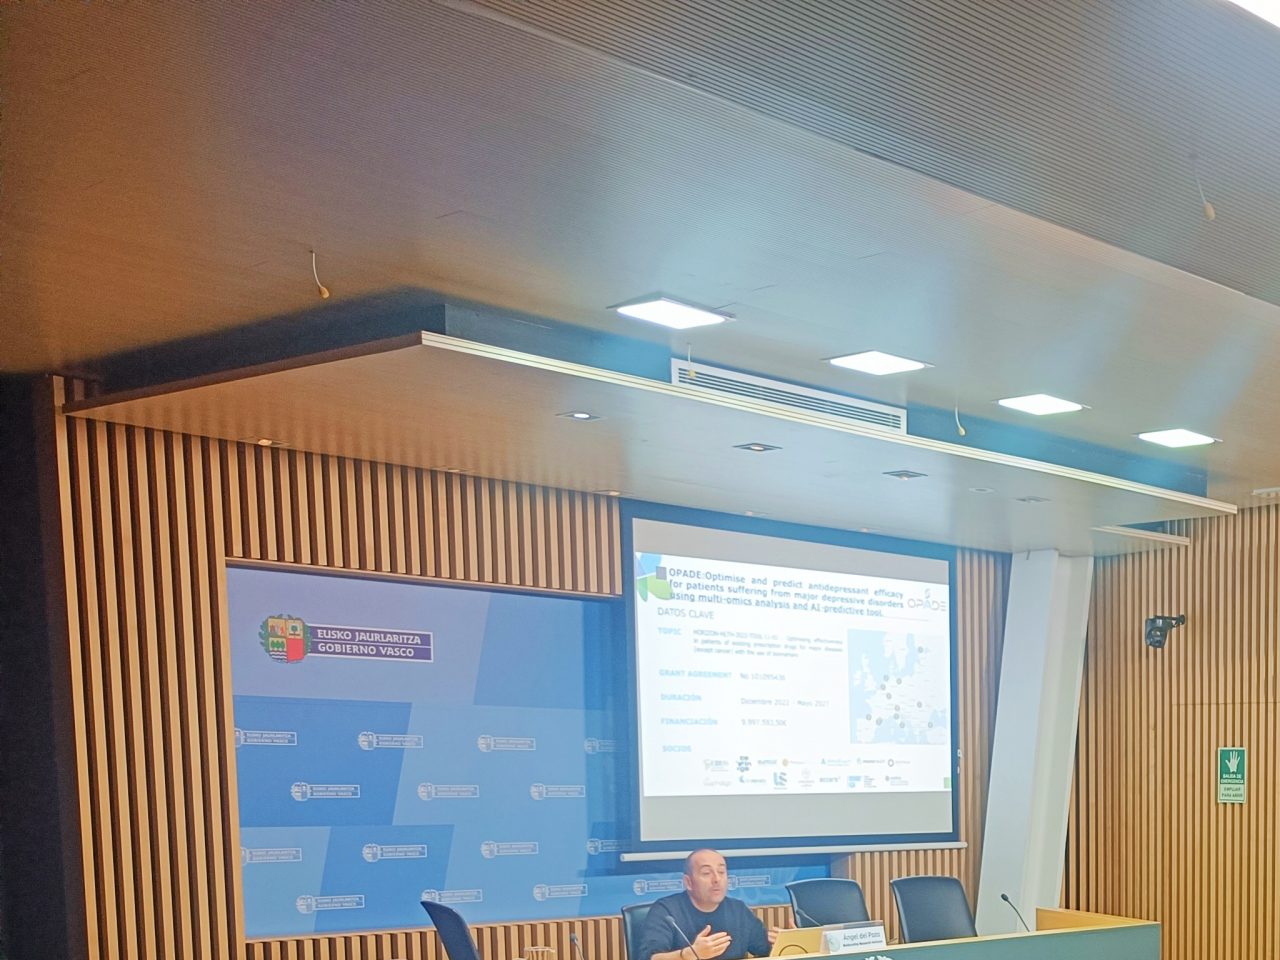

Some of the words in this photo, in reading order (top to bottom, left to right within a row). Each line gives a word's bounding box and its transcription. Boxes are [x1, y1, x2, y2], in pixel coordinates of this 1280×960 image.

[670, 578, 683, 590] for
[686, 581, 724, 595] patients
[727, 584, 768, 598] suffering
[770, 588, 791, 598] from
[794, 590, 818, 602] major
[821, 592, 866, 606] depressive
[868, 597, 904, 608] disorders
[751, 576, 768, 586] and
[772, 578, 803, 590] predict
[808, 581, 869, 595] antidepressant
[874, 588, 904, 600] efficacy
[657, 606, 686, 618] DATOS
[688, 609, 714, 620] CLAVE
[670, 592, 696, 604] using
[698, 592, 752, 606] multi-omics
[754, 597, 790, 611] analysis
[792, 600, 808, 610] and
[810, 602, 864, 616] AI-predictive
[317, 630, 352, 640] EUSKO
[354, 632, 422, 644] JAURLARITZA
[318, 643, 377, 655] GOBIERNO
[380, 646, 414, 657] VASCO
